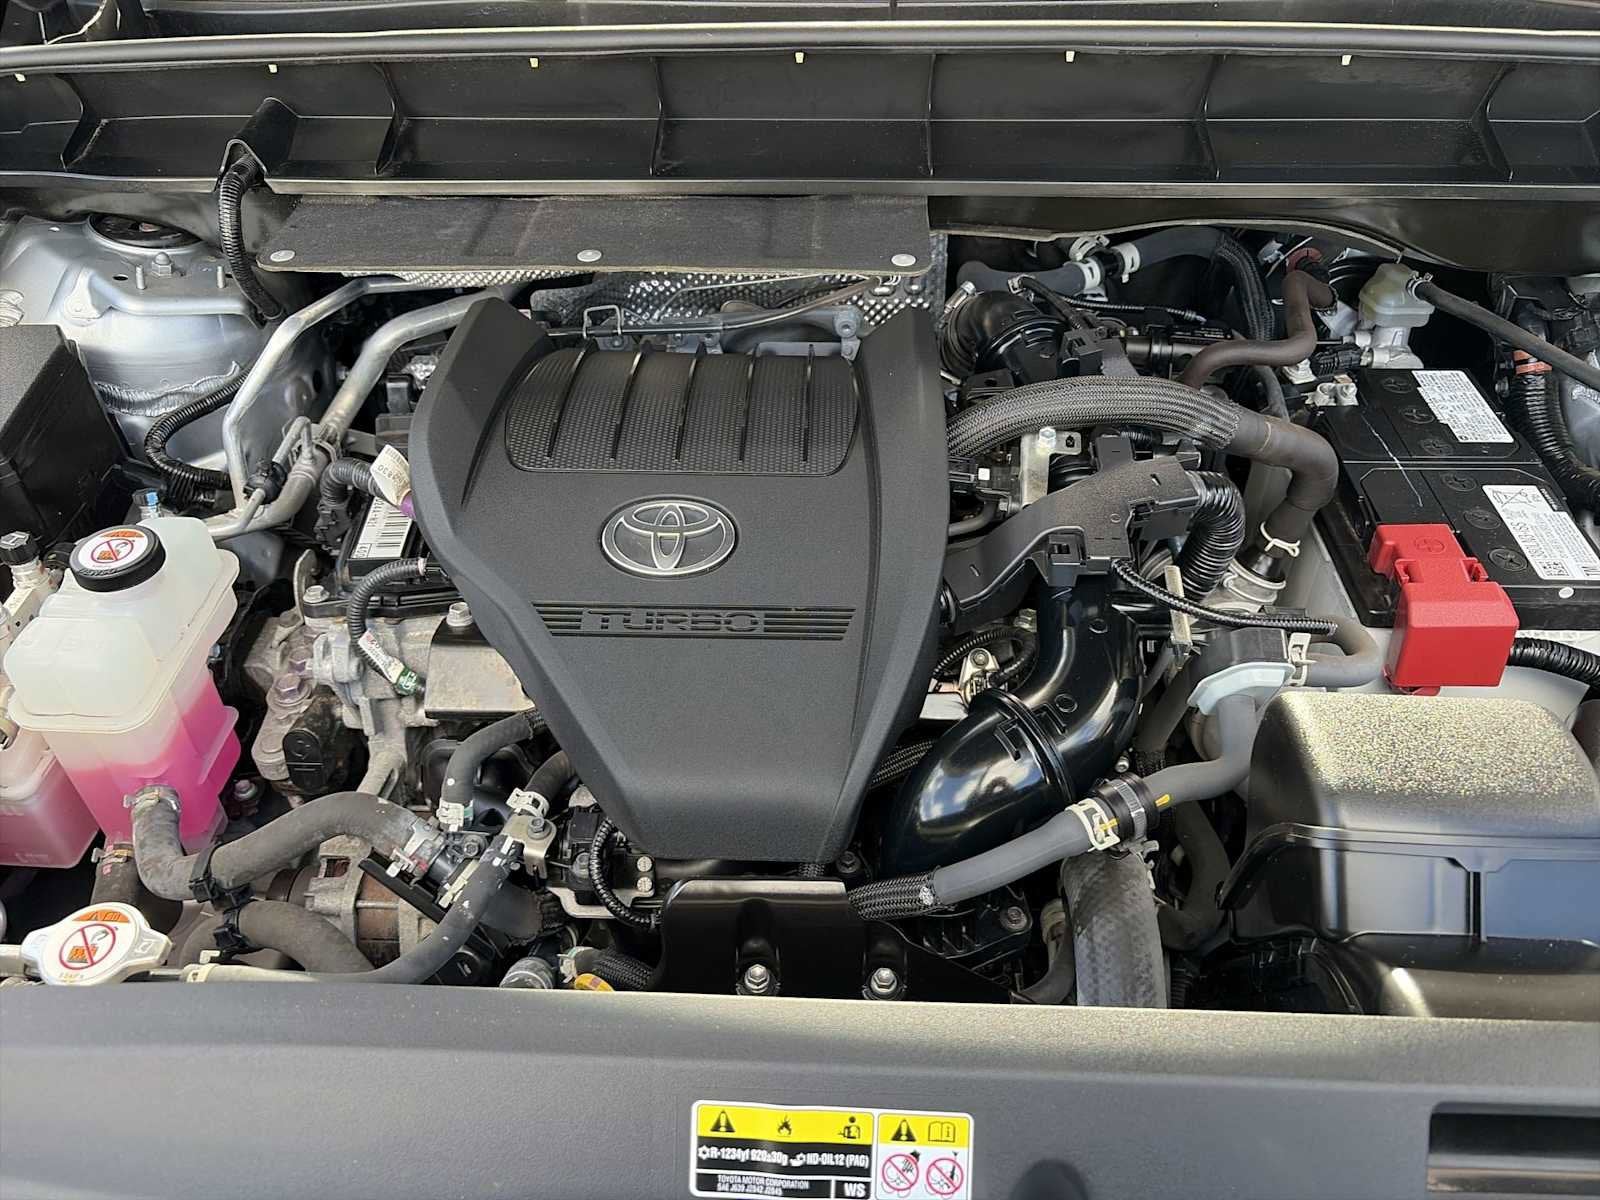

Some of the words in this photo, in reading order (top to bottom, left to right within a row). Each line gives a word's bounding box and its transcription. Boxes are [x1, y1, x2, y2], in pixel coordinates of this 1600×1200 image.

[586, 608, 759, 633] TURBO
[710, 1146, 750, 1162] R-1234yf
[846, 1154, 869, 1168] (PAG)
[717, 1174, 741, 1184] TOYOTA
[742, 1175, 765, 1186] MOTOR
[765, 1177, 809, 1189] CORPORATION
[844, 1182, 866, 1198] WS
